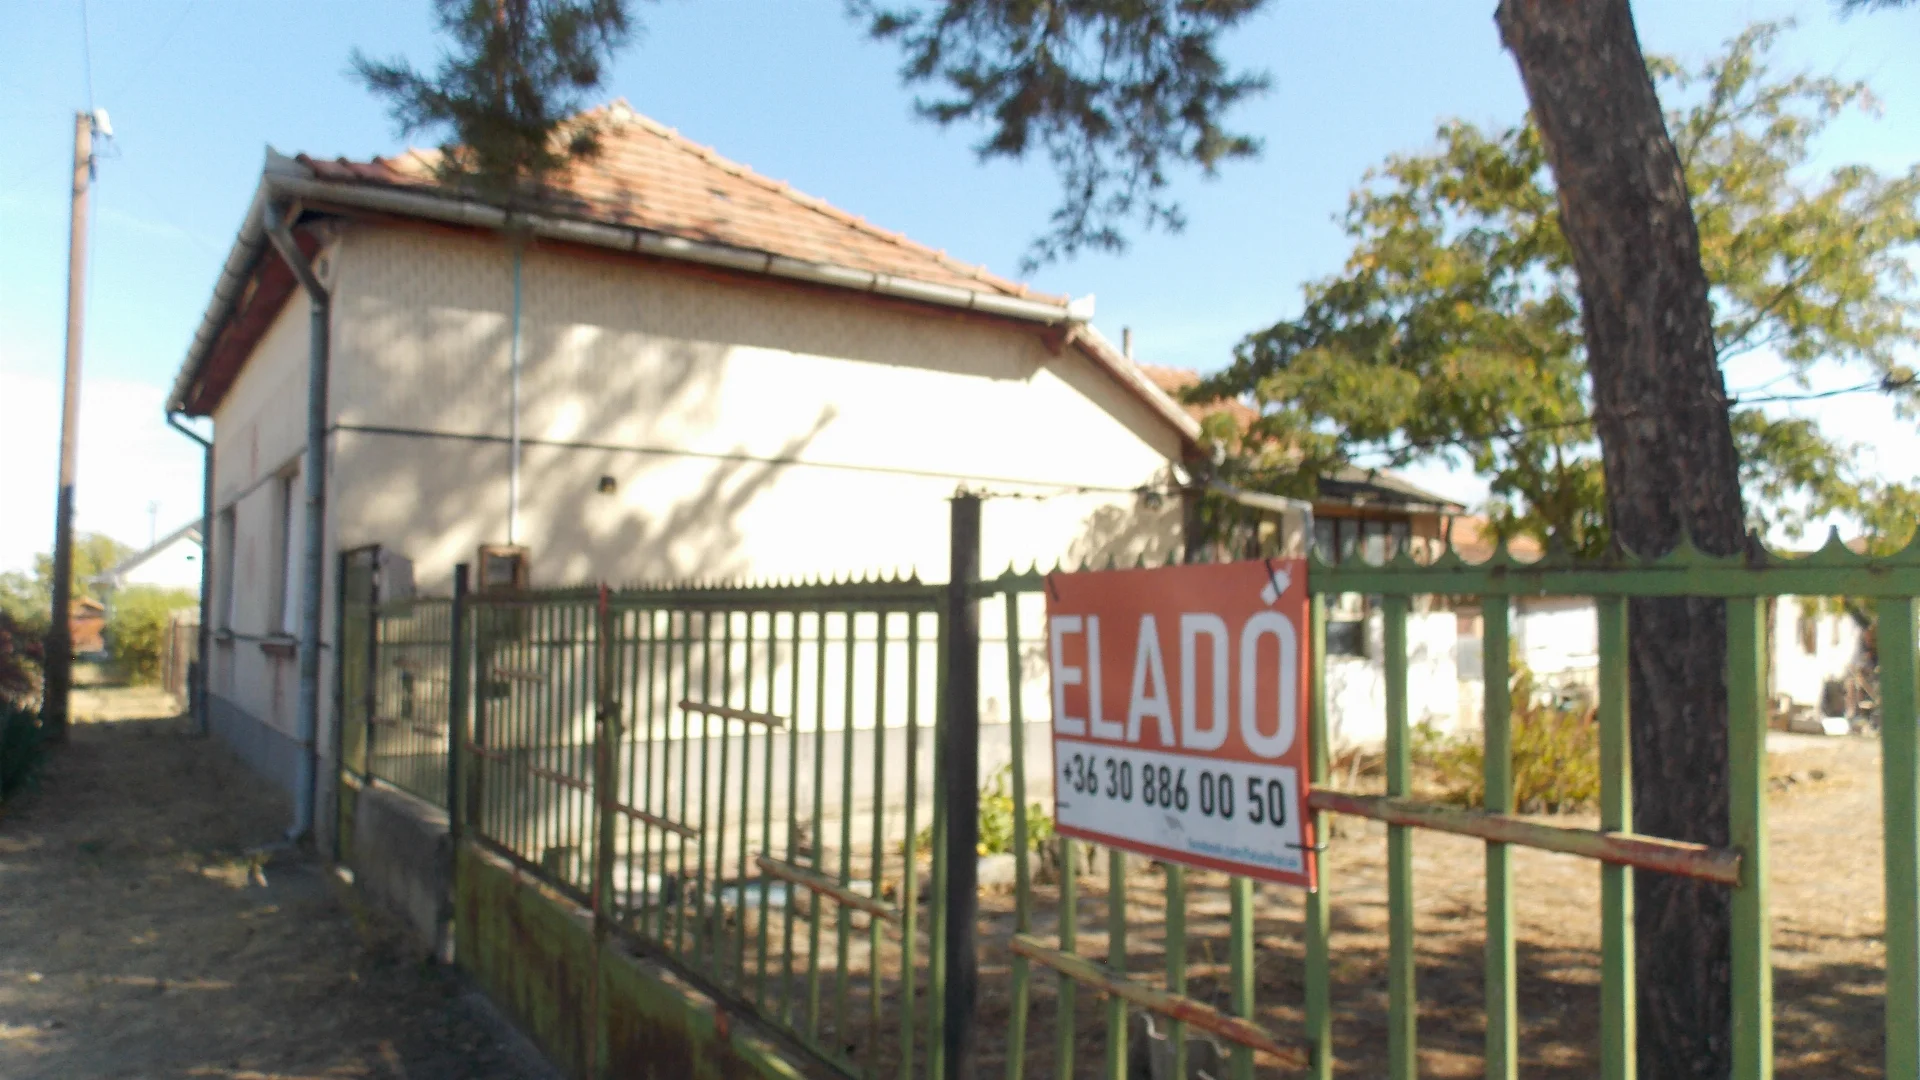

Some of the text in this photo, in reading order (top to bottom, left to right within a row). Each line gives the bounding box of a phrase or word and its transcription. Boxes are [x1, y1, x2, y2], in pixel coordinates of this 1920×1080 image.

[1050, 566, 1297, 759] ELADÓ
[1063, 753, 1286, 827] +36 30 886 00 50
